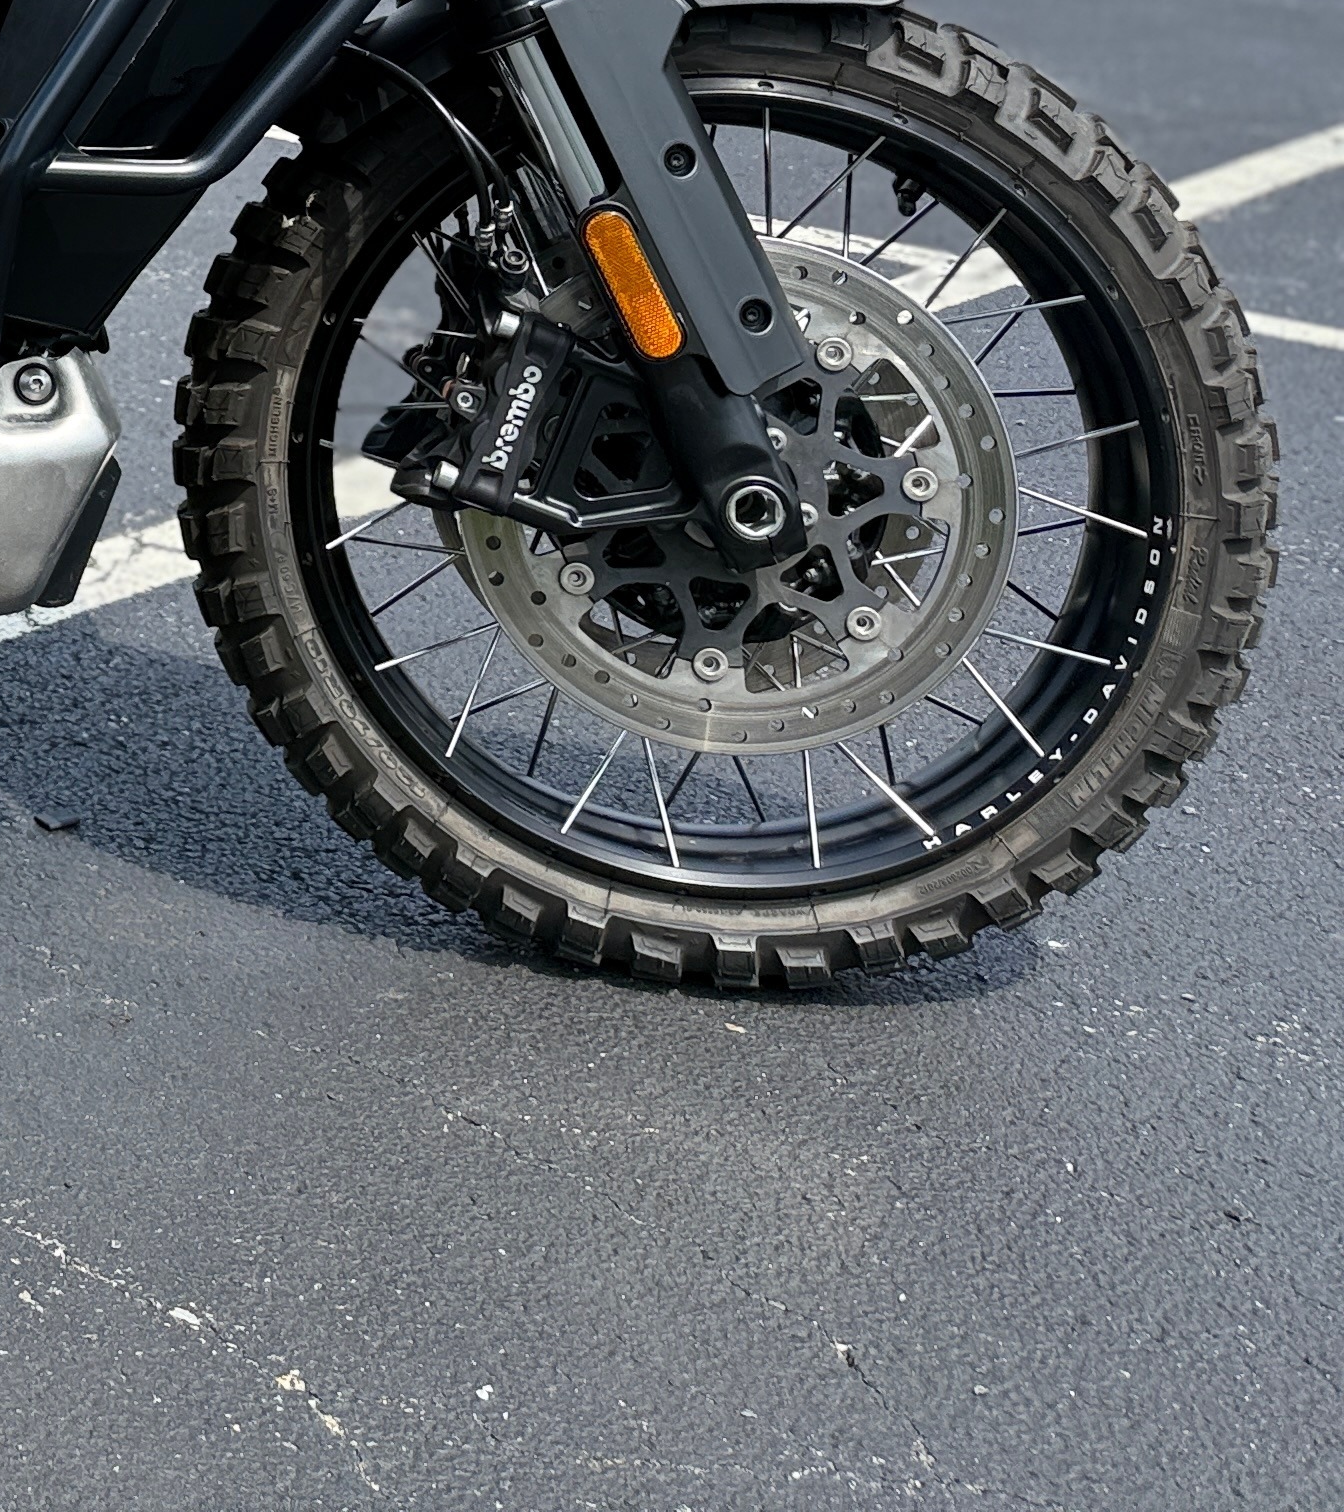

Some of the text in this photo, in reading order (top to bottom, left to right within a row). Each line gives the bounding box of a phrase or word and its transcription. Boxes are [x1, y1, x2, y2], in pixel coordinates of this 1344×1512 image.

[481, 365, 543, 471] brembo
[922, 515, 1164, 851] HARLEY-DAVIDSON
[1063, 682, 1166, 810] MICHELIN
